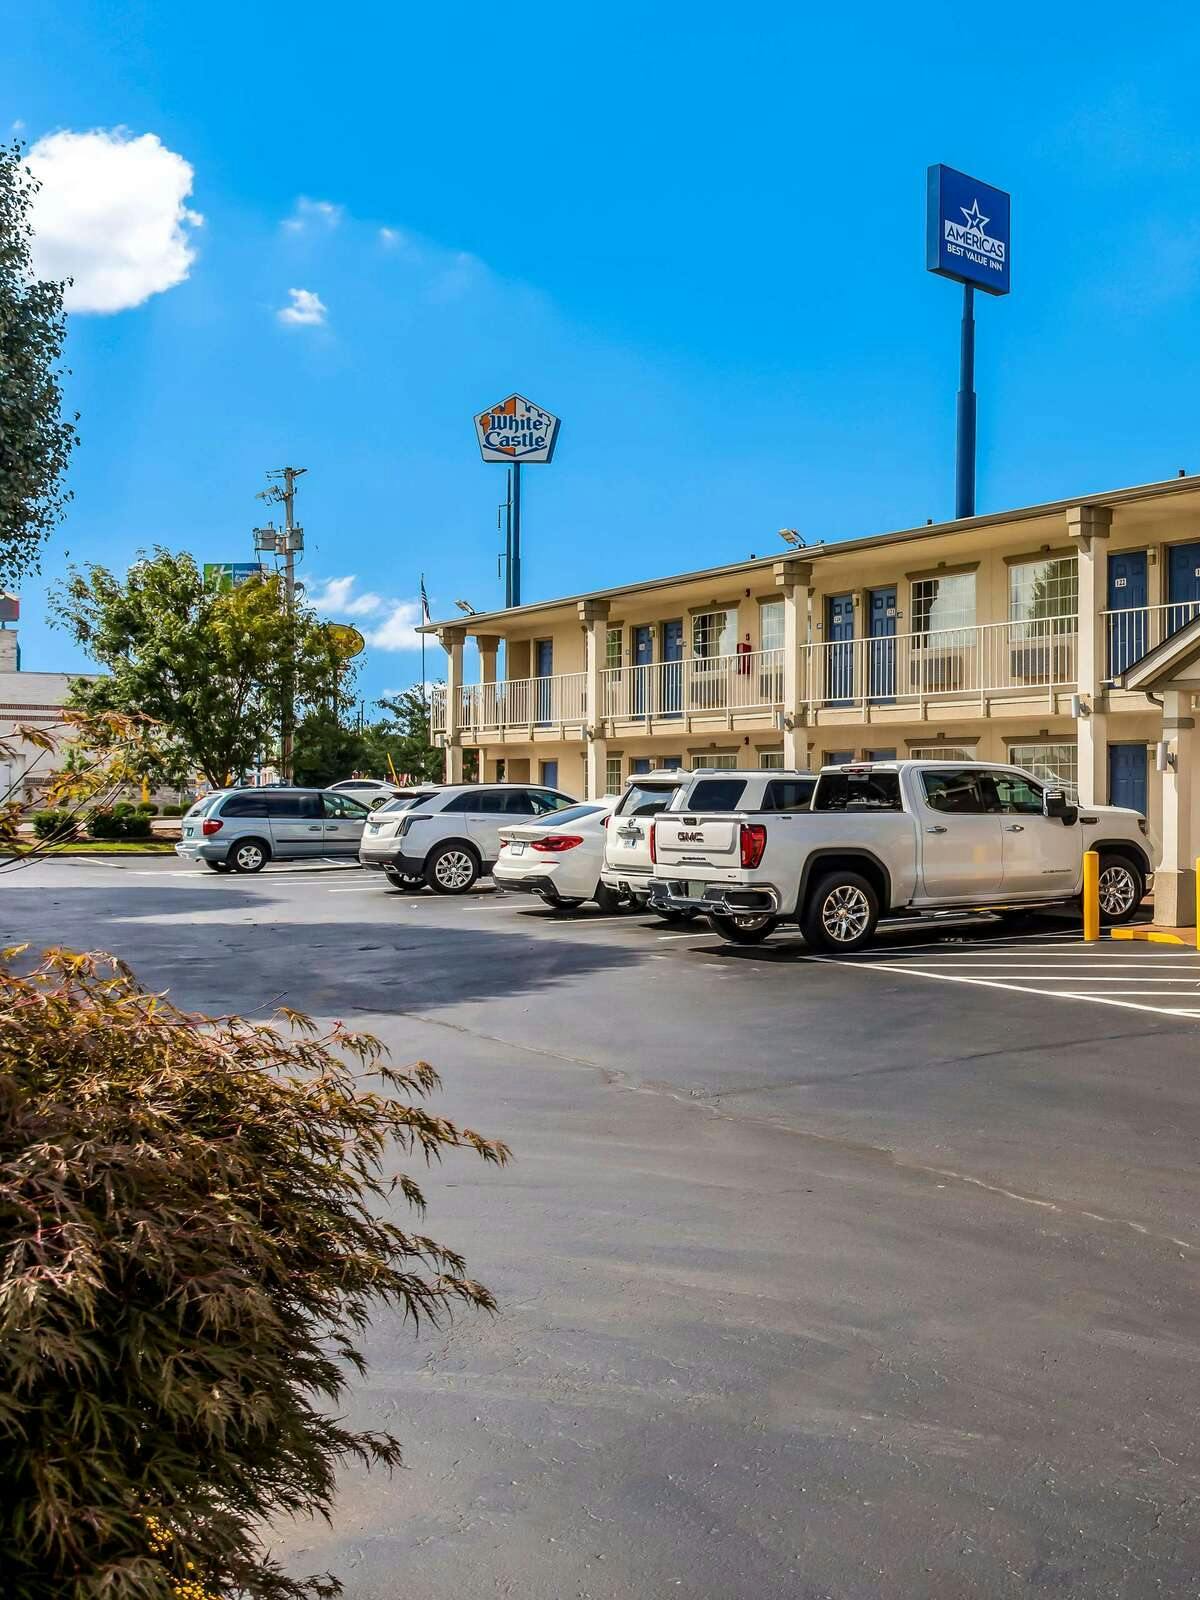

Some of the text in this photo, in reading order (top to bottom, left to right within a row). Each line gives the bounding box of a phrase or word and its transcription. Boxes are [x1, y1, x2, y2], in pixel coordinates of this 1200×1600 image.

[946, 225, 1004, 258] AMERICAS
[947, 243, 1003, 272] BEST VALUE INN
[488, 414, 543, 433] White
[485, 431, 546, 448] Castle
[677, 831, 704, 843] GMC
